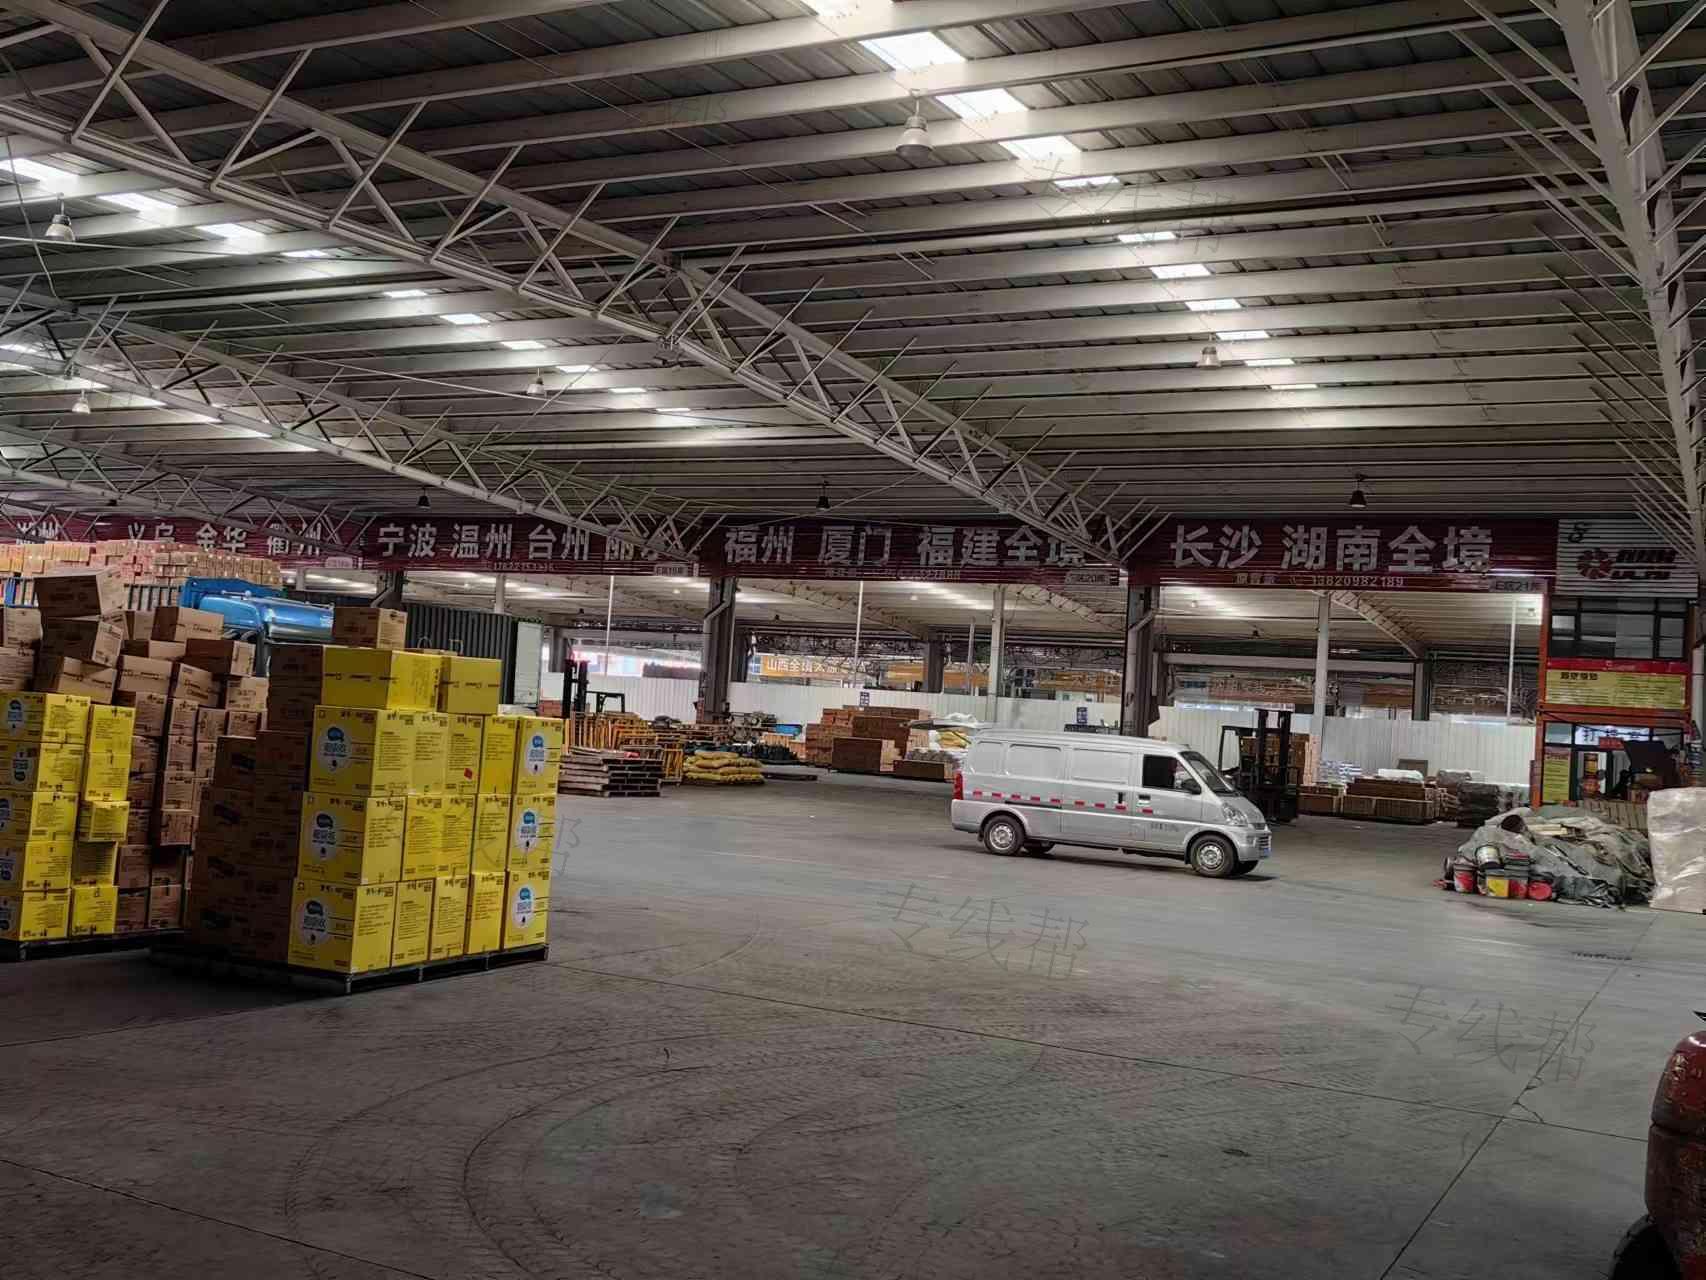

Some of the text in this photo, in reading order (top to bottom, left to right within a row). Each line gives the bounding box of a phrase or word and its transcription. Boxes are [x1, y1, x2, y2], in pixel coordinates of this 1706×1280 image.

[196, 523, 247, 553] 金华
[378, 522, 437, 558] 宁波
[449, 523, 513, 559] 温州
[527, 524, 590, 560] 台州
[724, 526, 1087, 567] 福州 厦门 福建全境
[1170, 524, 1495, 573] 长沙 湖南全境
[1312, 575, 1404, 587] 13820982189
